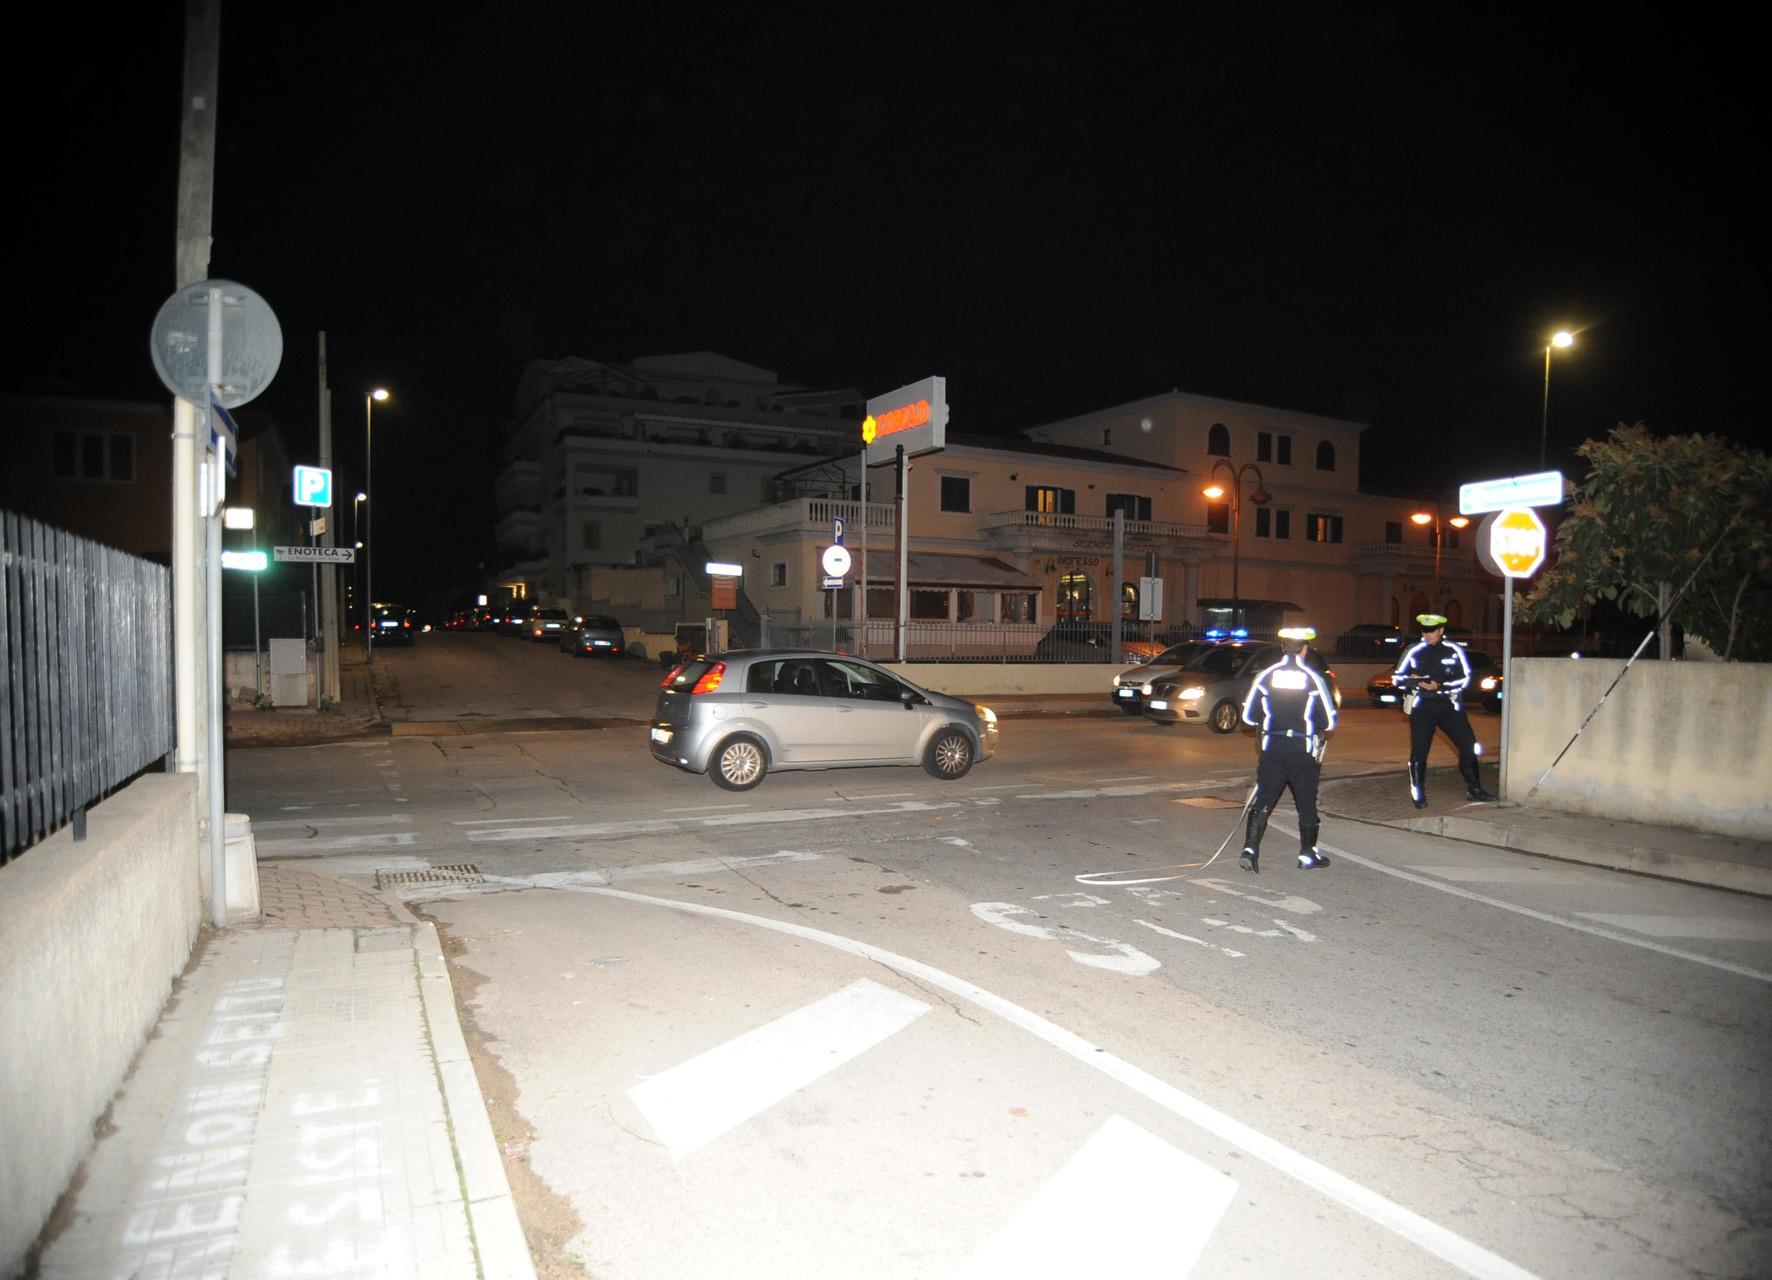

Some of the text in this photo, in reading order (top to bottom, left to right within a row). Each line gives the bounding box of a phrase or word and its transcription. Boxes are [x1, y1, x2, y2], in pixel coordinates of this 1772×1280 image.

[302, 473, 325, 502] P
[834, 520, 843, 544] P
[288, 547, 339, 557] ENOTECA
